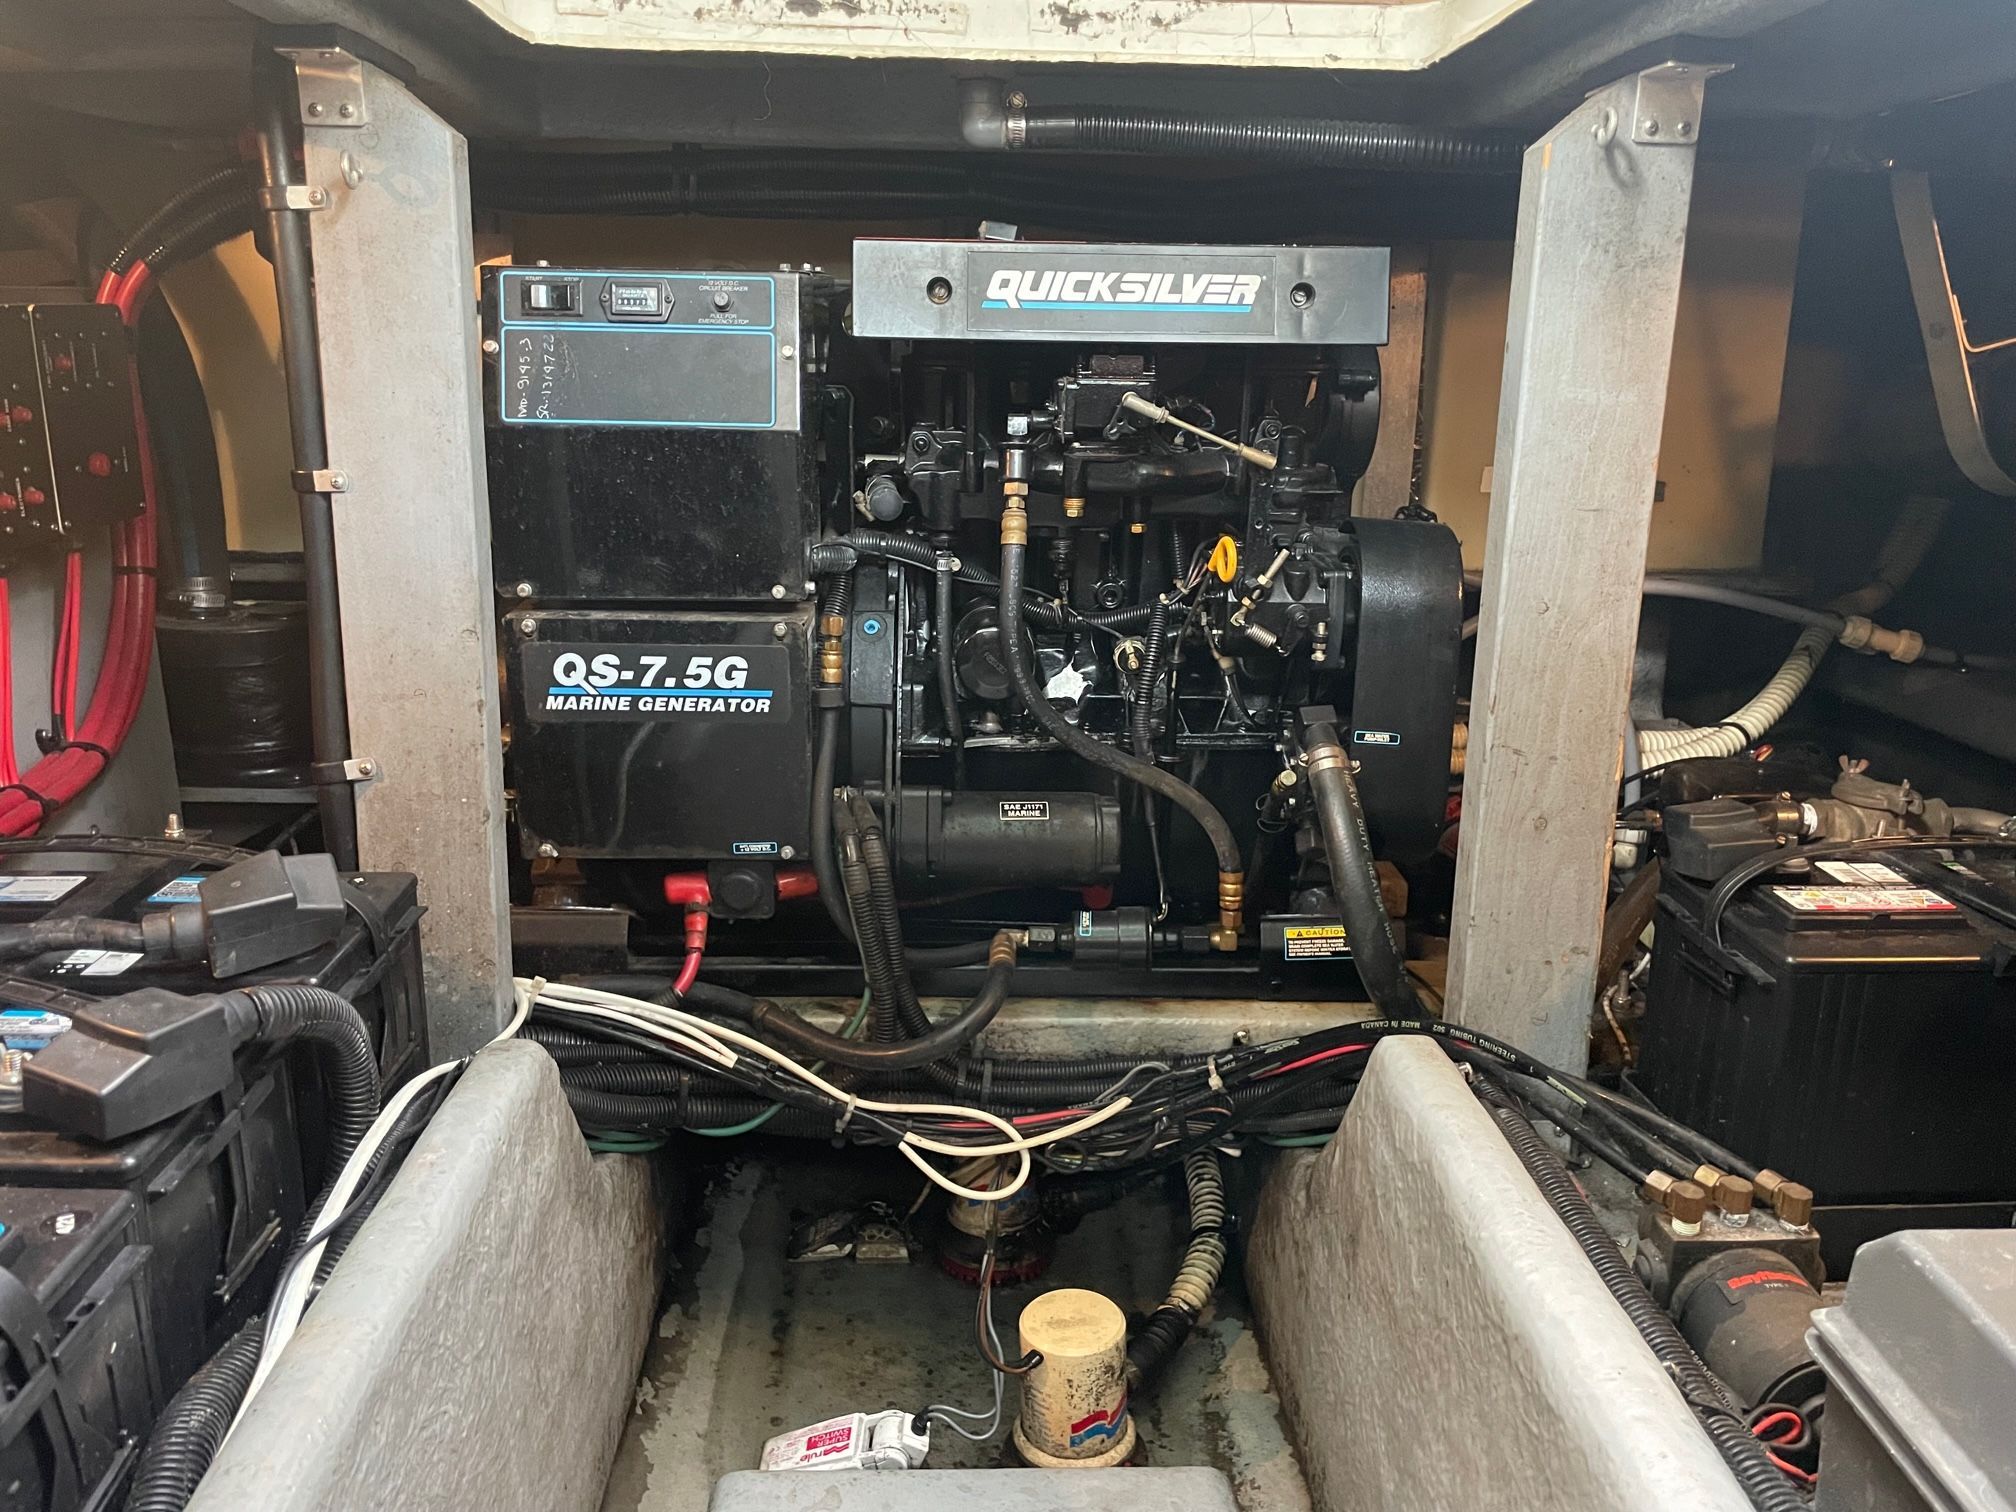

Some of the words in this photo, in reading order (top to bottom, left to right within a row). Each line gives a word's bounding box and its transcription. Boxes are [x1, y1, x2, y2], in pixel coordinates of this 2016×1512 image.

[986, 269, 1262, 309] QUICKSILVER
[553, 652, 749, 695] QS-7.5G
[545, 696, 632, 712] MARINE
[638, 697, 771, 713] GENERATOR
[1356, 818, 1370, 851] DUTY
[1360, 1020, 1389, 1029] CANADA
[1400, 1020, 1421, 1029] MADE
[1449, 1028, 1478, 1044] TUBING
[1478, 1038, 1517, 1063] STEERING
[811, 1429, 850, 1441] SWITCH
[816, 1435, 849, 1448] SUPER
[799, 1450, 823, 1463] rule
